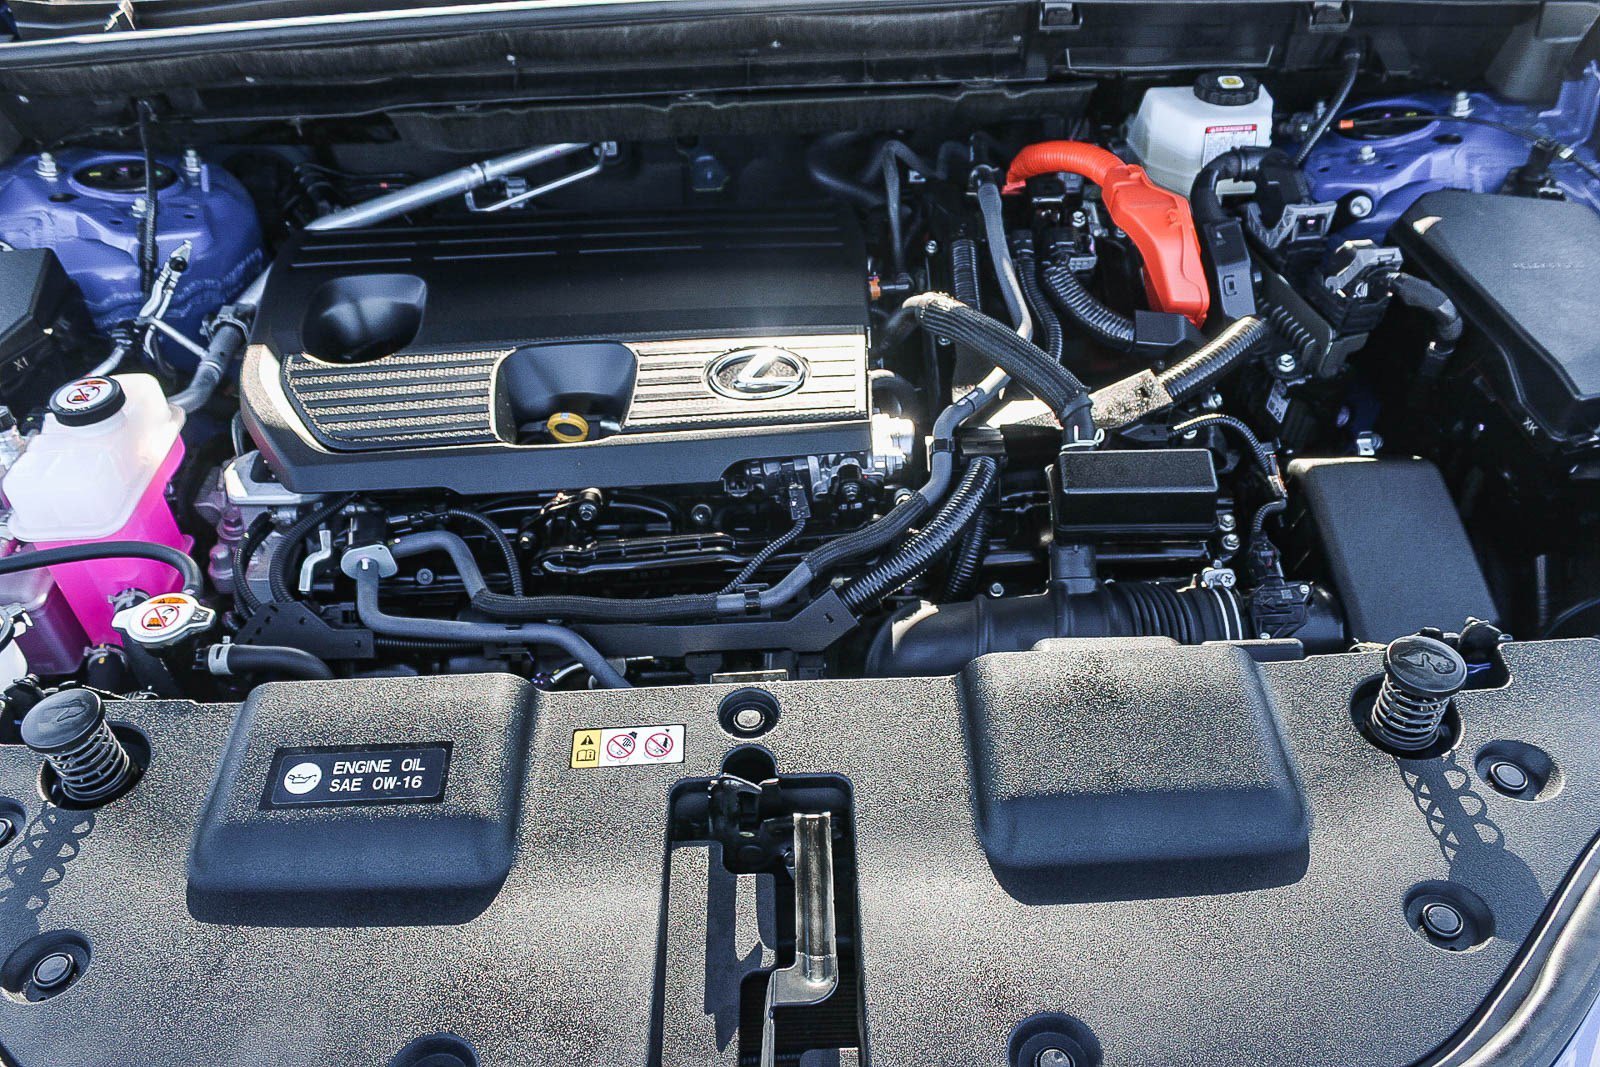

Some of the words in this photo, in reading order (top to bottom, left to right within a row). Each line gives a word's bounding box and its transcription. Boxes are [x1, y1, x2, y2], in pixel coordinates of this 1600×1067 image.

[333, 759, 392, 775] ENGINE
[401, 758, 426, 771] OIL
[329, 778, 363, 792] SAE
[372, 776, 422, 790] 0W-16
